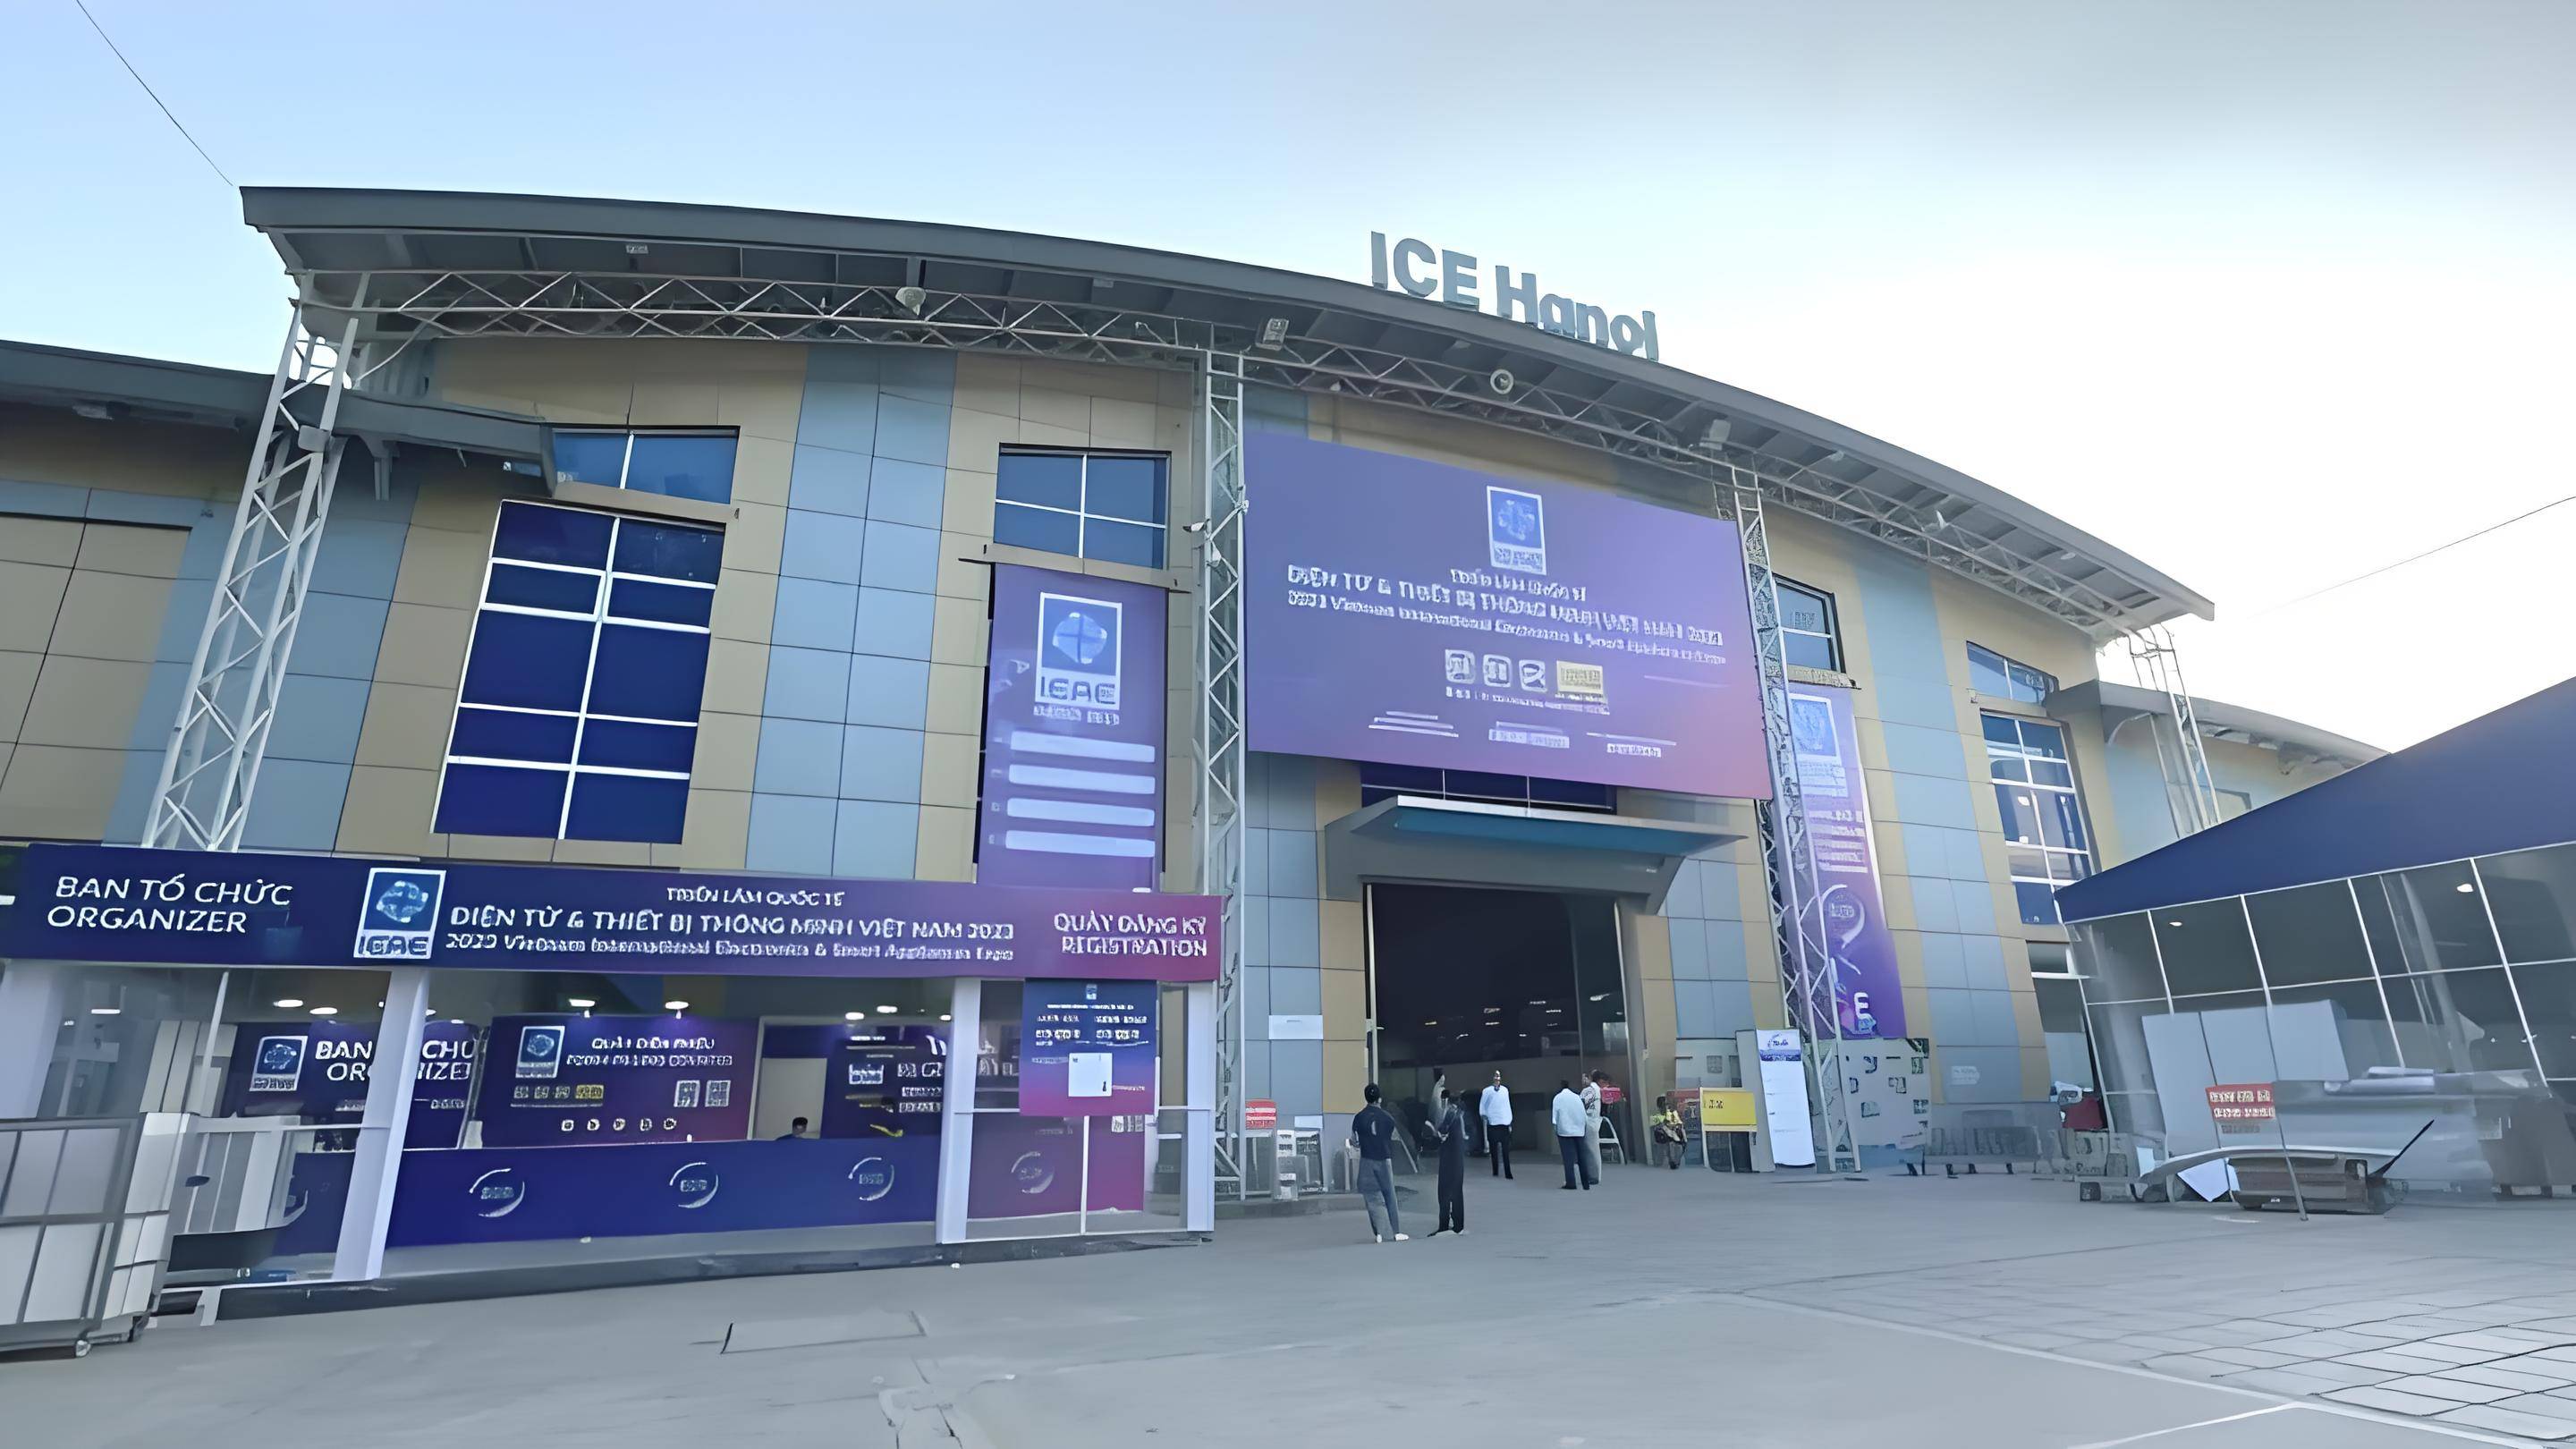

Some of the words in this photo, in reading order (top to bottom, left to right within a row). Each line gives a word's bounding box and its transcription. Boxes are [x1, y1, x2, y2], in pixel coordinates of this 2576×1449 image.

[1370, 231, 1479, 311] ICE
[55, 876, 131, 899] BAN
[47, 905, 246, 933] ORGANIZER
[1062, 936, 1208, 958] REGISTRATION
[315, 1040, 373, 1060] BAN
